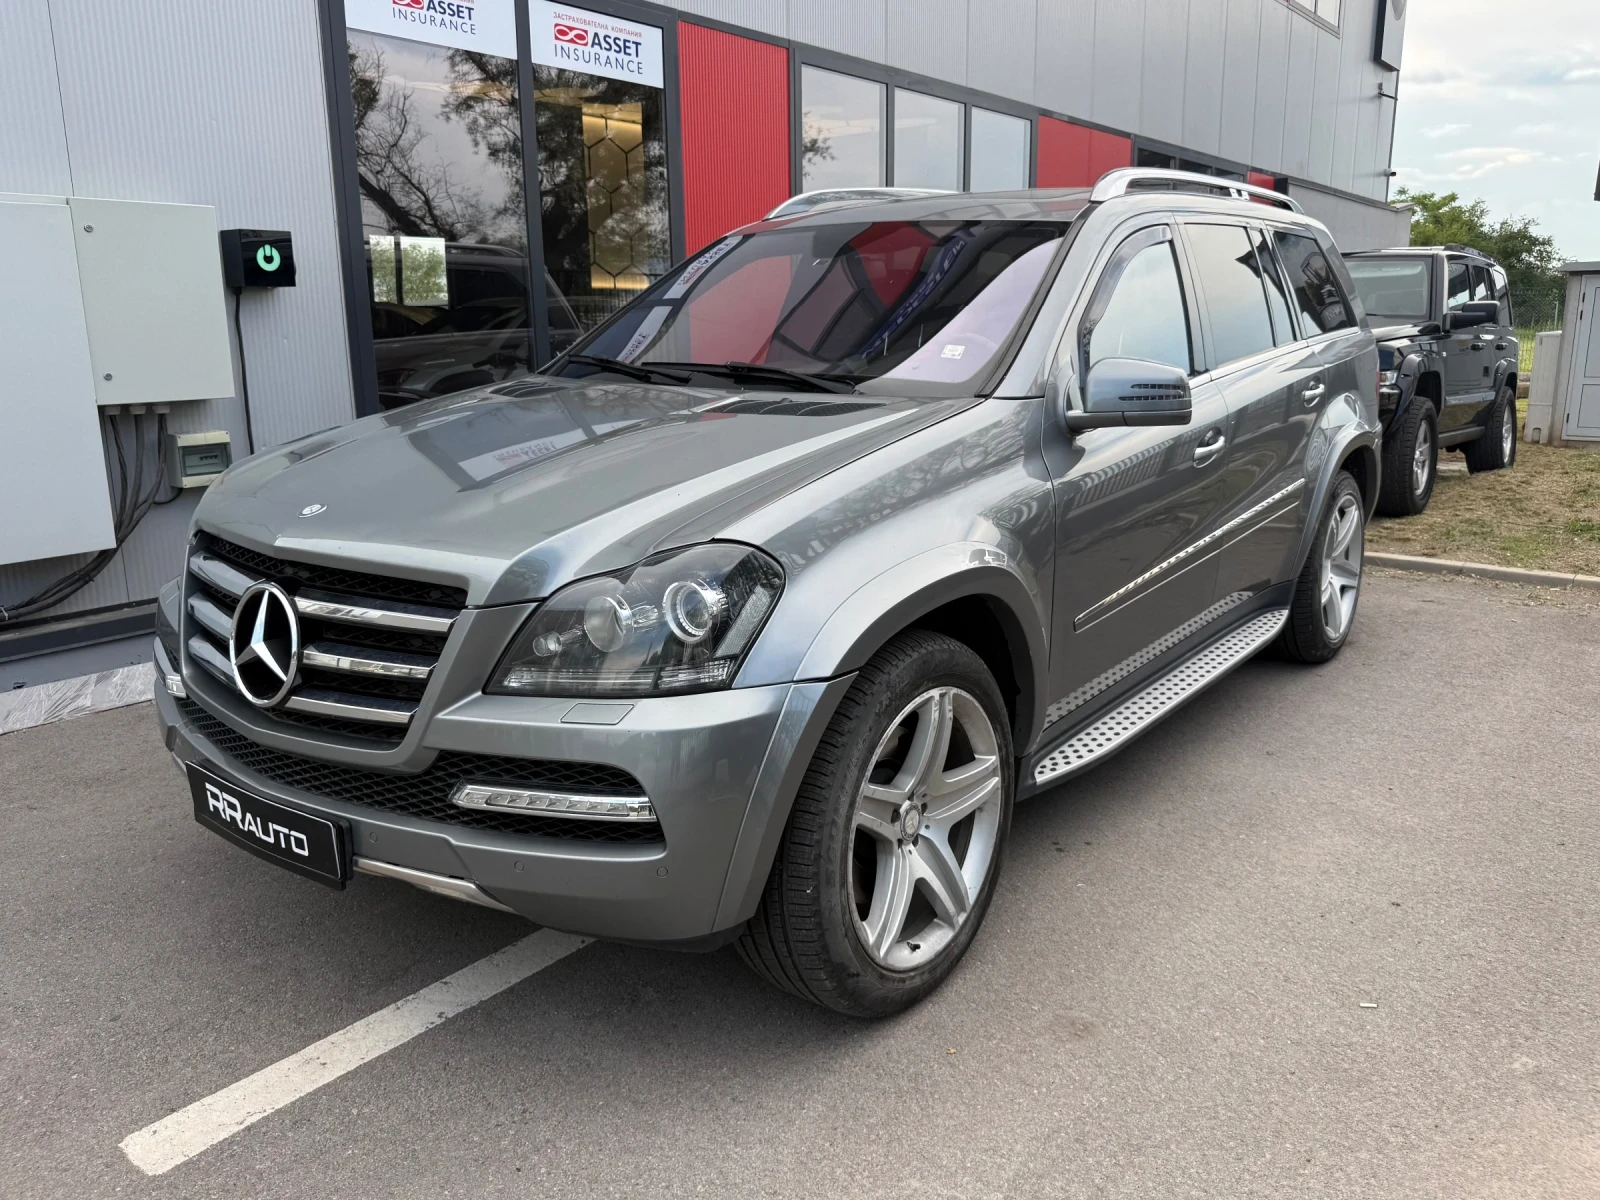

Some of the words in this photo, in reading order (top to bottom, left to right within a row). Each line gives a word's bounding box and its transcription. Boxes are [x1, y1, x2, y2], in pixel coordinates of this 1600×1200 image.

[392, 7, 476, 35] INSURANCE
[426, 0, 474, 20] ASSET
[553, 12, 609, 31] ЗАСТРАХОВАТЕЛНА
[611, 26, 642, 38] КОМПАНИЯ
[591, 32, 642, 58] ASSET
[554, 44, 643, 75] INSURANCE
